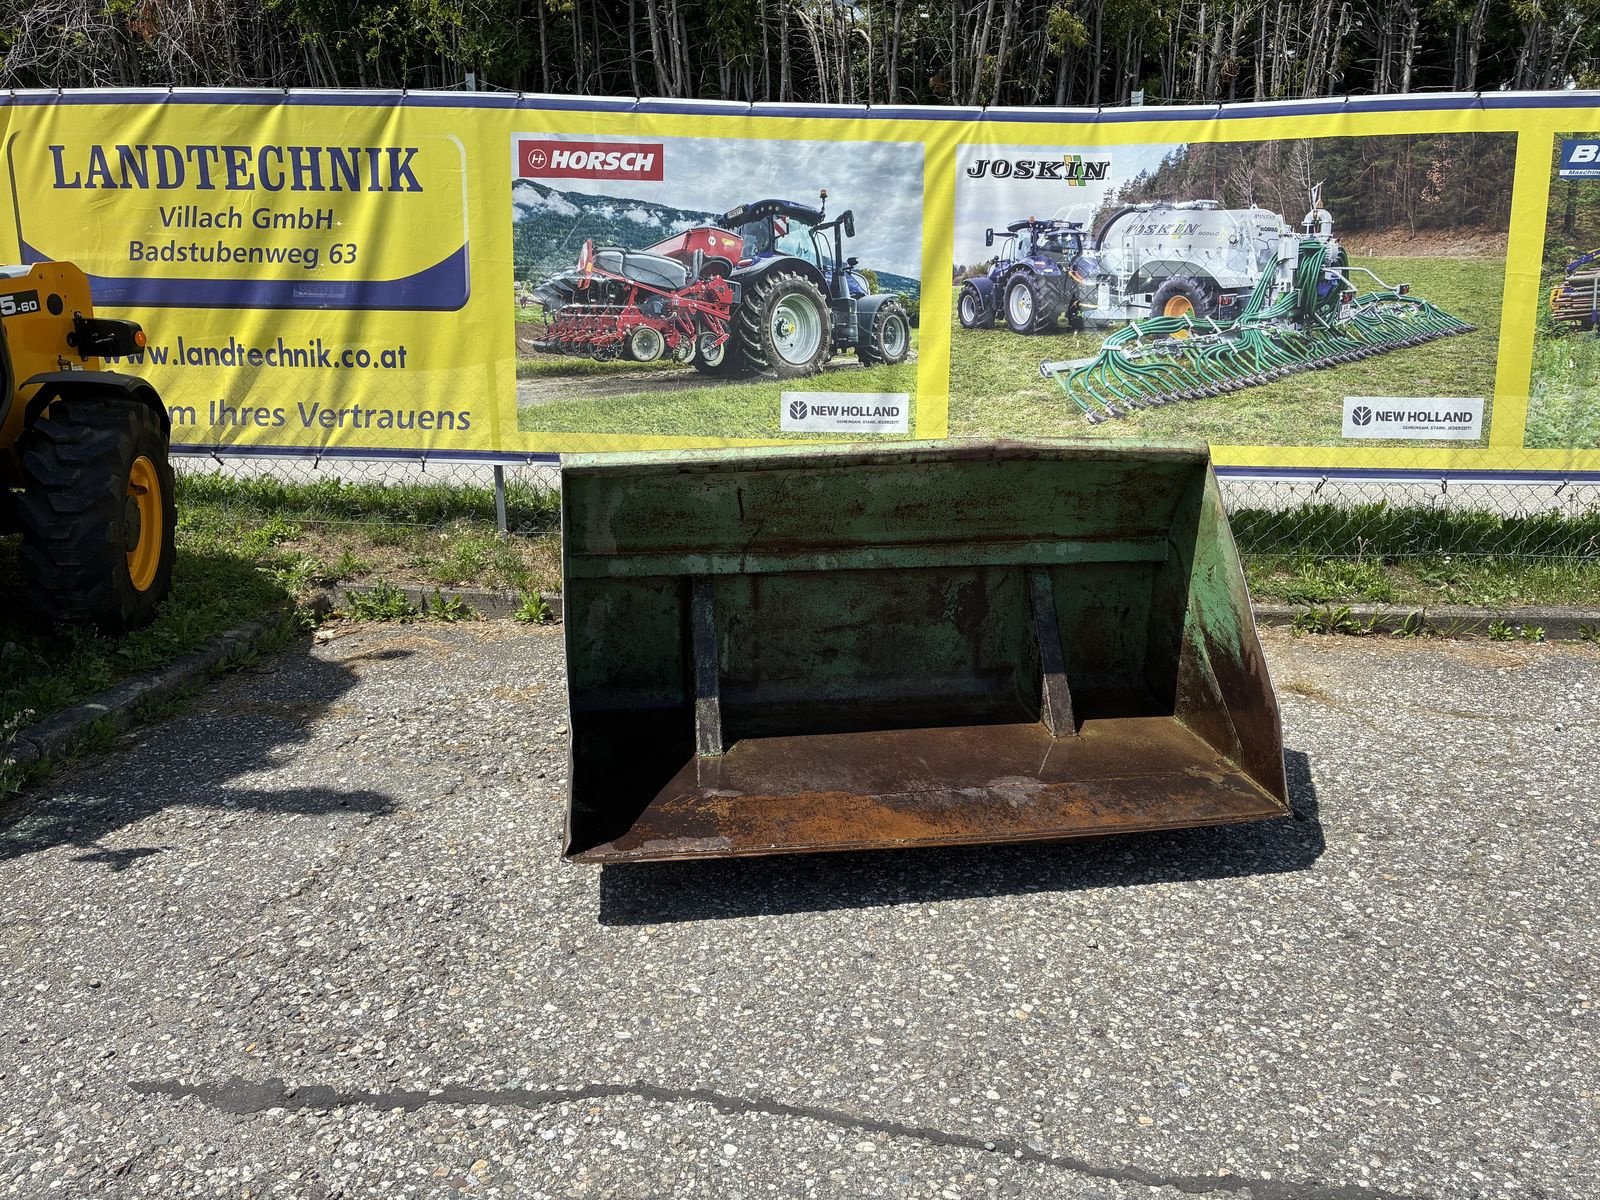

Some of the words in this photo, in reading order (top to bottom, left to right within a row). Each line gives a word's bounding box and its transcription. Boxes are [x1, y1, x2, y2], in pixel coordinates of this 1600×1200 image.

[48, 144, 424, 193] LANDTECHNIK
[550, 149, 655, 172] HORSCH
[966, 159, 1110, 181] JOSKIN
[159, 206, 243, 229] Villach
[252, 206, 334, 230] GmbH
[128, 240, 319, 269] Badstubenweg
[328, 242, 358, 264] 63
[209, 399, 285, 428] Ihres
[297, 402, 471, 431] Vertrauens
[810, 405, 839, 416] NEW
[841, 406, 900, 417] HOLLAND
[1375, 411, 1406, 422] NEW
[1408, 411, 1473, 423] HOLLAND
